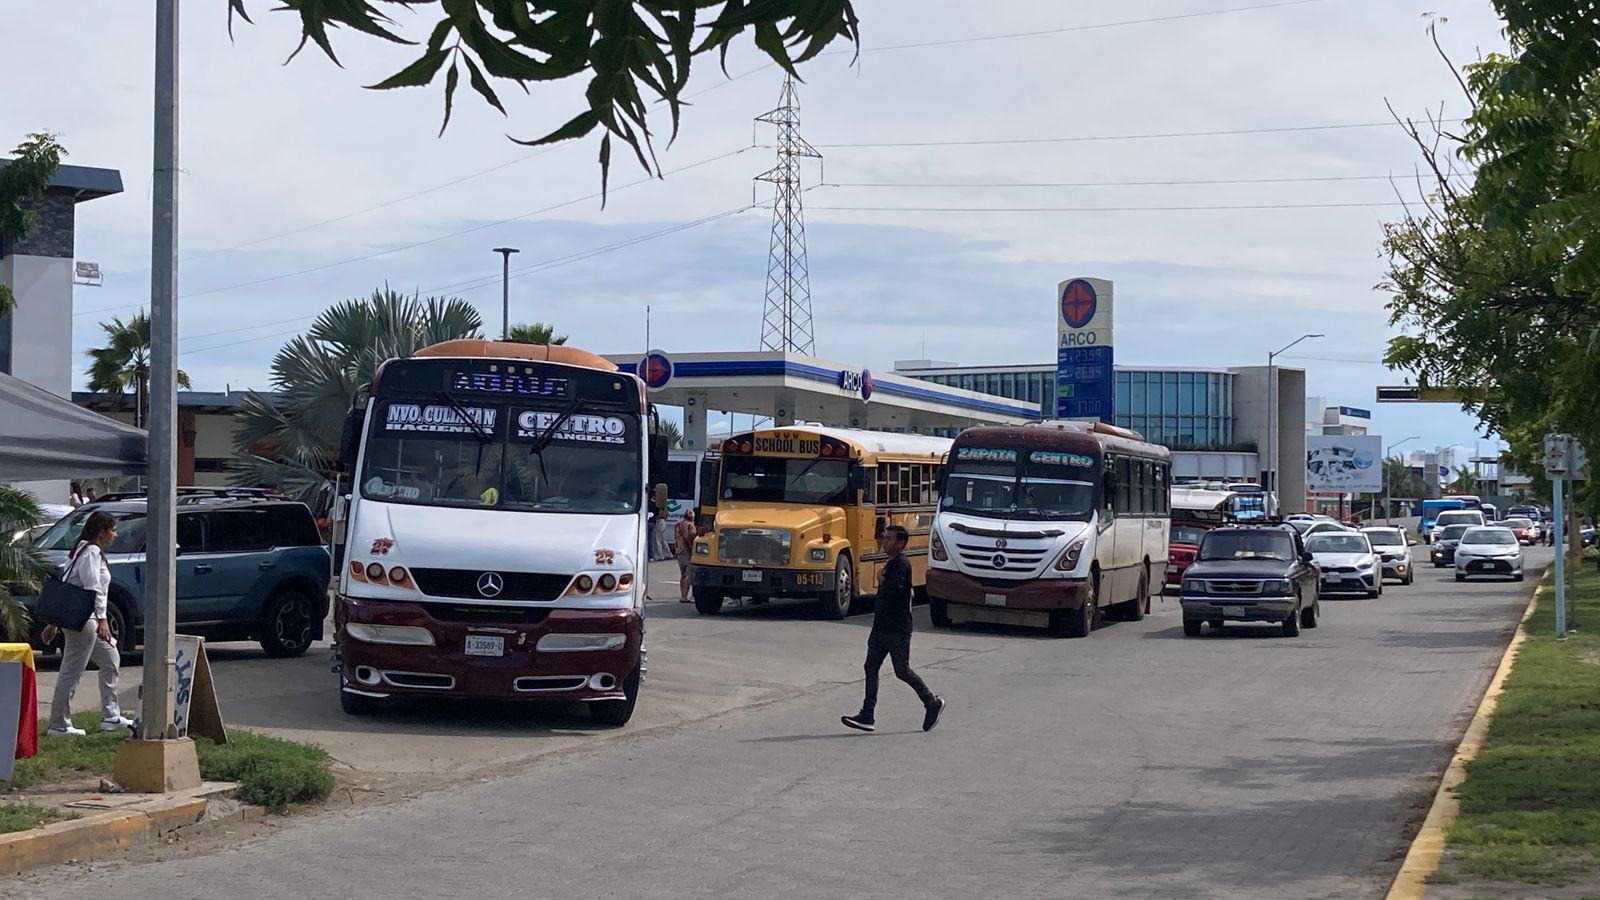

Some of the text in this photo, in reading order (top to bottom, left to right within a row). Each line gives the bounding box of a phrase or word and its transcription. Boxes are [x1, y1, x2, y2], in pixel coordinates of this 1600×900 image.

[1061, 331, 1096, 346] ARCO
[843, 370, 862, 391] ARCO
[387, 404, 423, 424] NVO.
[755, 438, 819, 454] SCHOOL BUS
